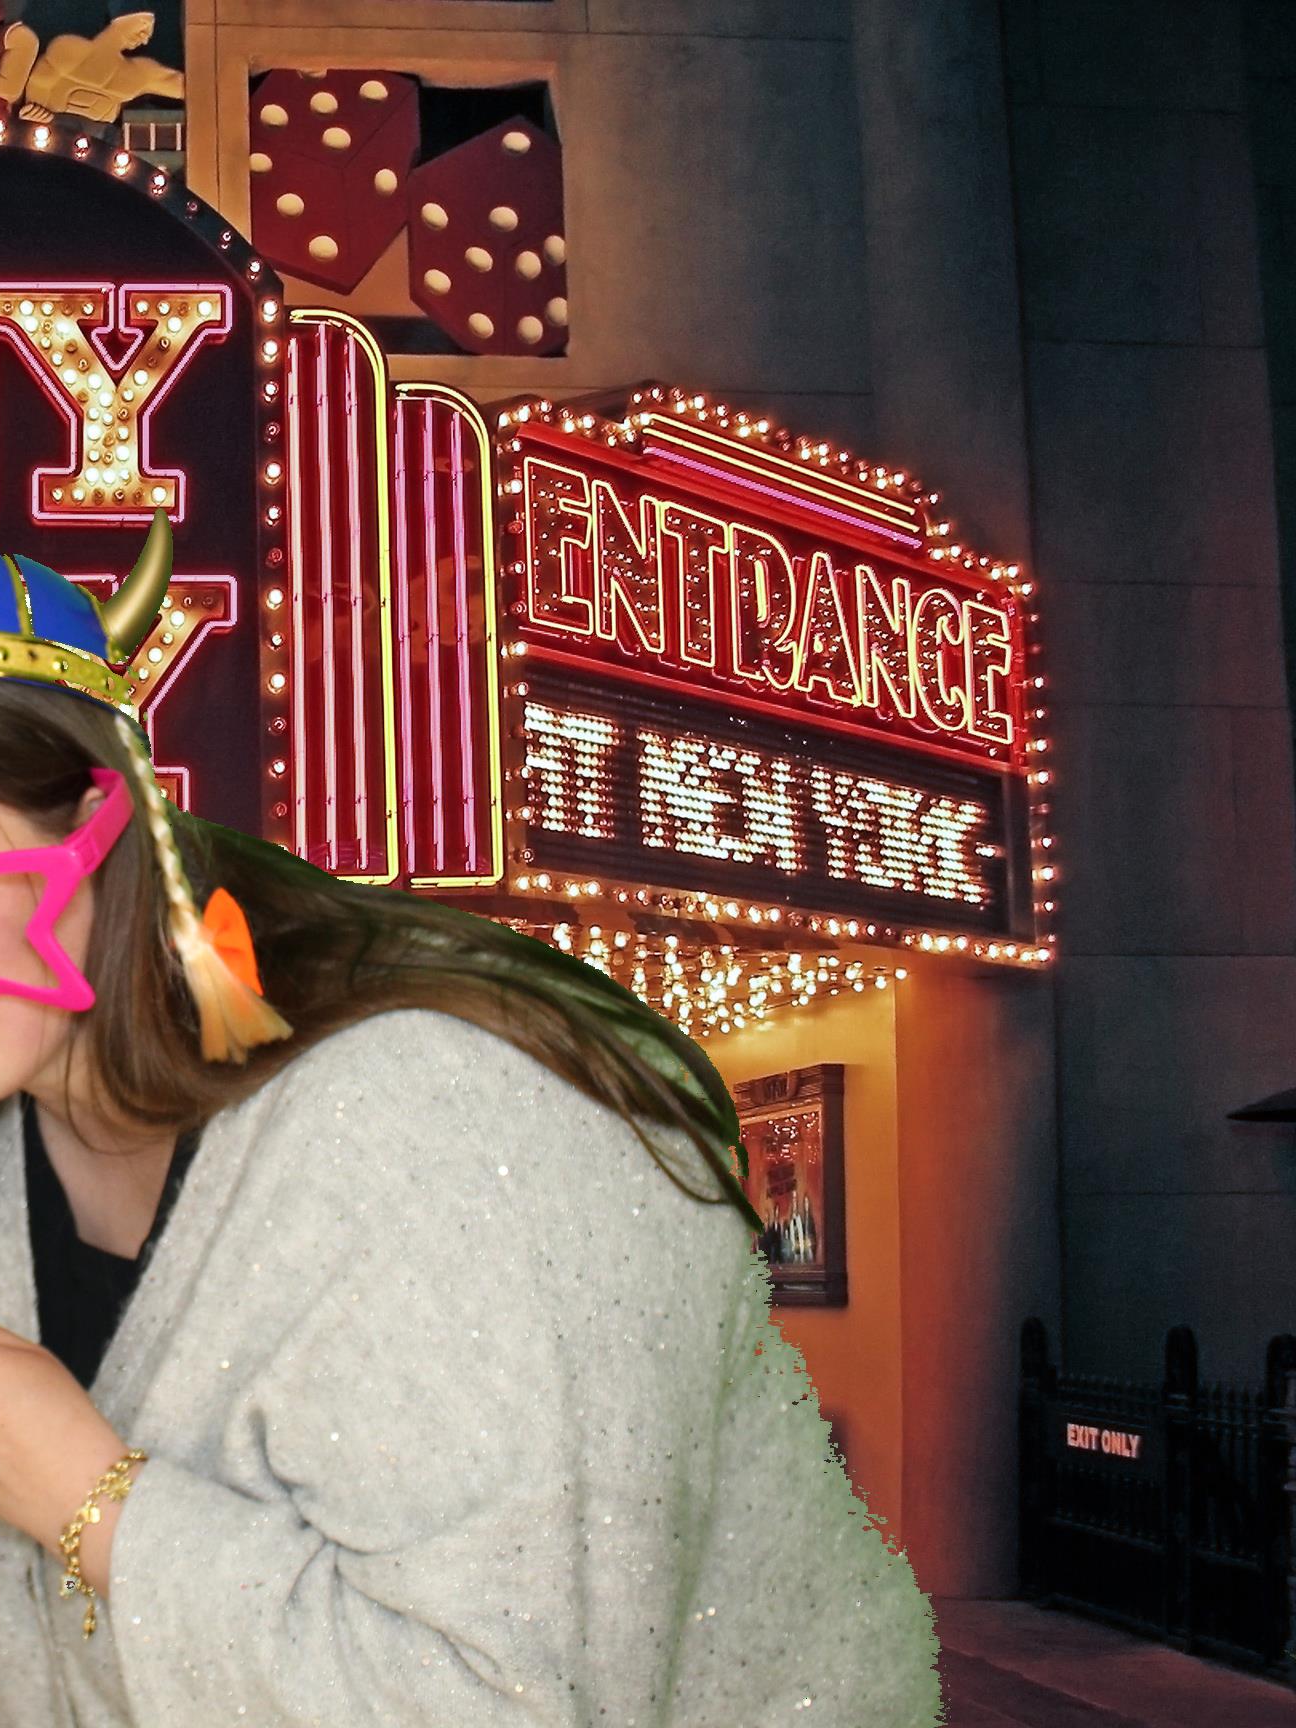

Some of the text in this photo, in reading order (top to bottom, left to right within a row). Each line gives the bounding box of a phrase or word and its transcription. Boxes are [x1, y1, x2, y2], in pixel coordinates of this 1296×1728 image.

[523, 457, 1014, 744] ENTRANCE
[1067, 1423, 1140, 1458] EXIT ONLY
